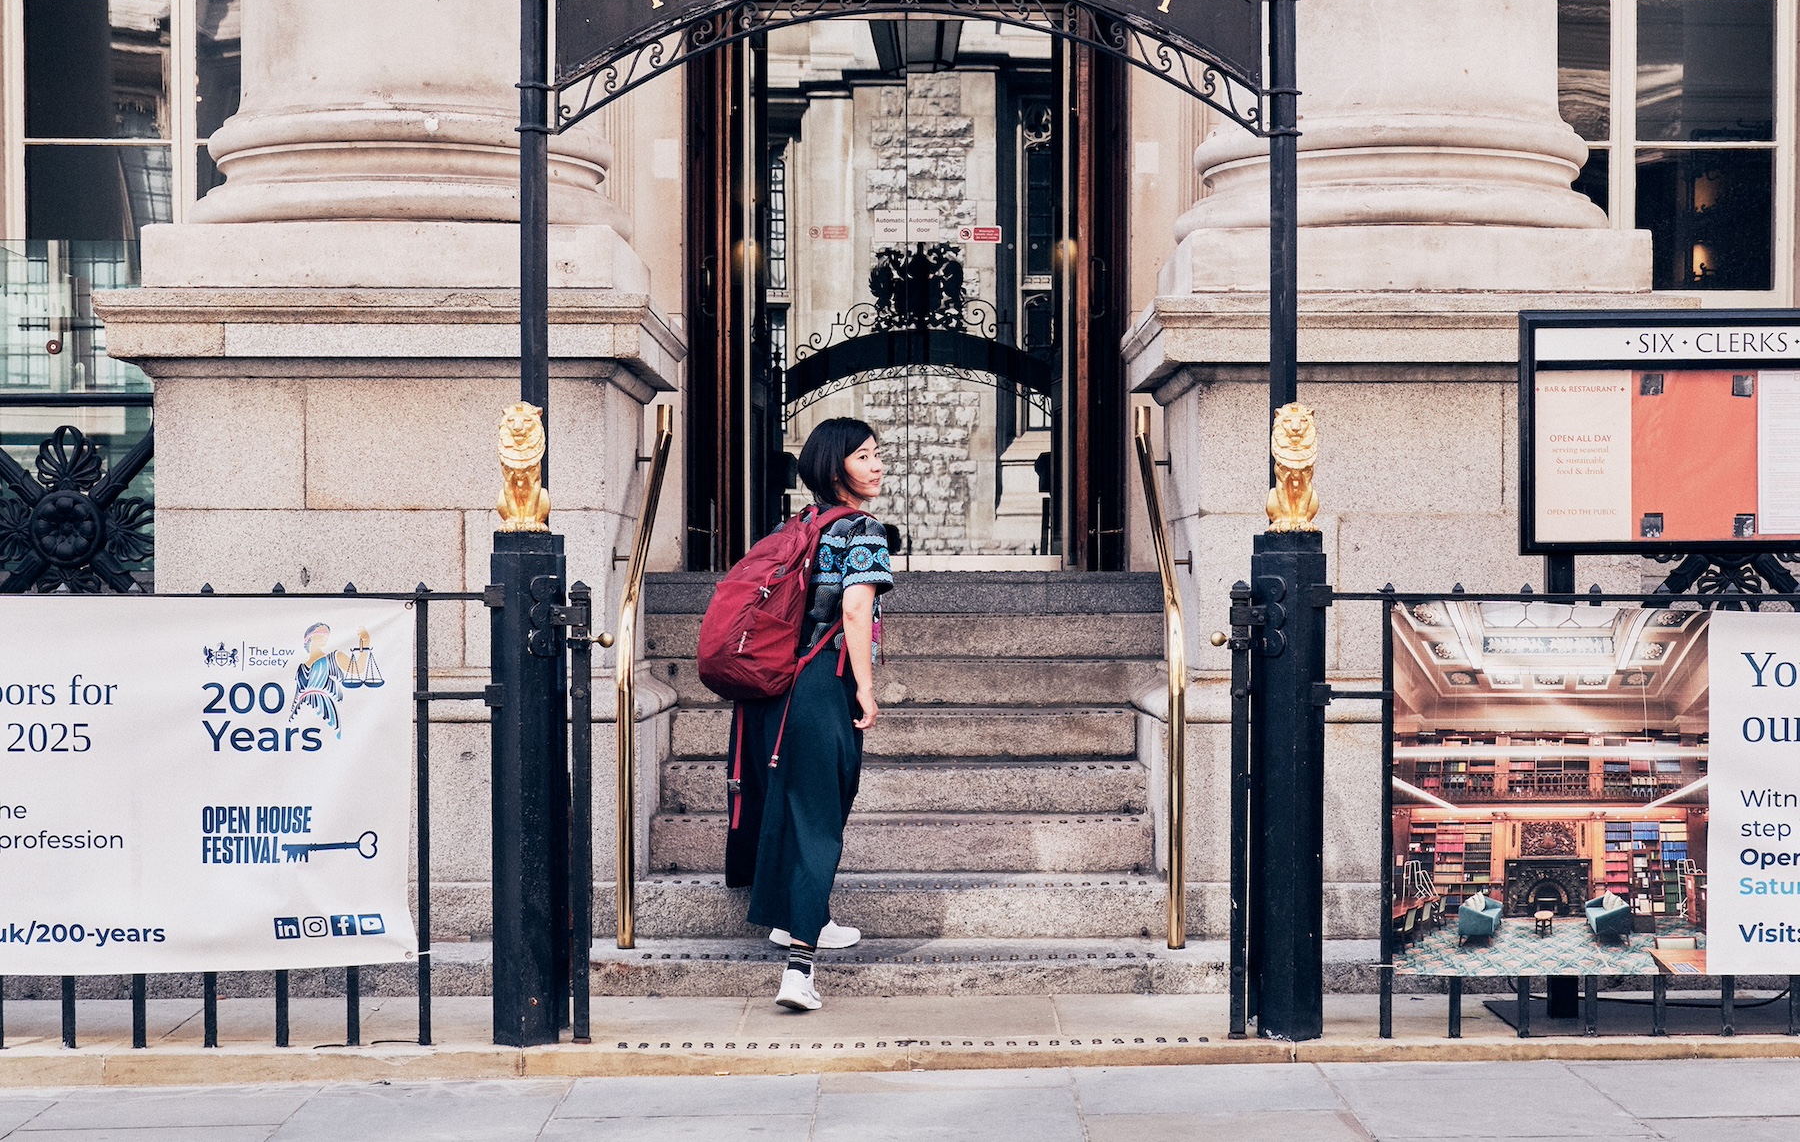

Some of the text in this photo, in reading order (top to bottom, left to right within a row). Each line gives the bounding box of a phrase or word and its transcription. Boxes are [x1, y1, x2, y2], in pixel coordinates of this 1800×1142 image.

[1638, 332, 1788, 353] SIX CLERKS
[1544, 385, 1617, 393] BAR & RESTAURANT
[1549, 434, 1612, 442] OPEN ALL DAY
[1552, 445, 1609, 454] serving seasonal
[1565, 456, 1605, 464] sustainable
[1556, 467, 1573, 475] food
[1585, 467, 1605, 475] drink
[249, 647, 295, 656] The Law
[248, 657, 288, 668] Society
[1740, 652, 1800, 688] Yo
[0, 674, 118, 706] ors for
[202, 682, 285, 714] 200
[7, 723, 92, 753] 2025
[202, 720, 323, 752] Years
[1740, 789, 1798, 808] Witn
[202, 806, 313, 834] OPEN HOUSE
[0, 830, 124, 853] profession
[1740, 820, 1792, 842] step
[202, 836, 281, 864] FESTIVAL
